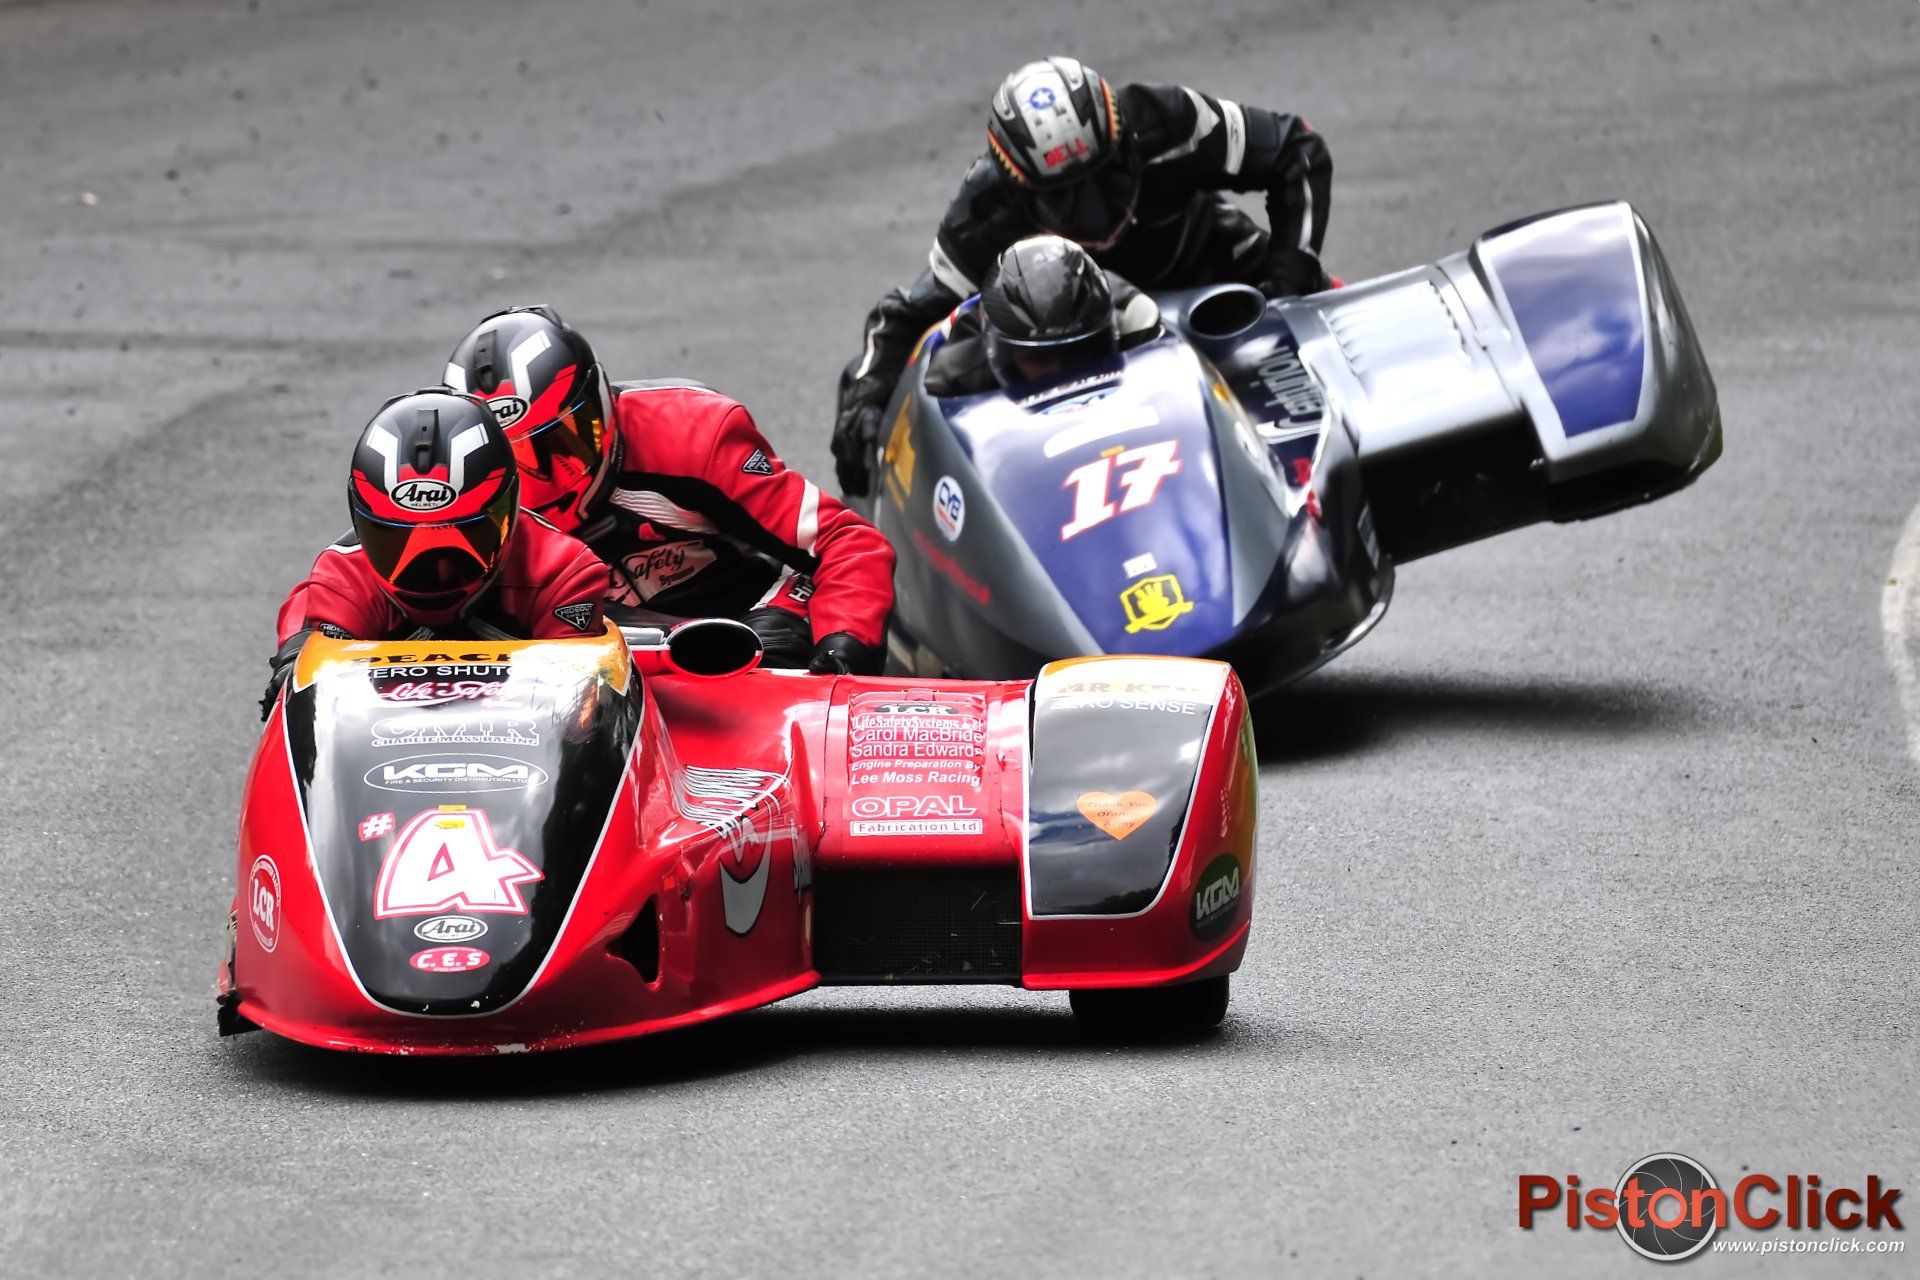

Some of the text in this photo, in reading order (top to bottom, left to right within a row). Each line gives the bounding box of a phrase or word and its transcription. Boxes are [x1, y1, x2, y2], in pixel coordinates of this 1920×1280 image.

[396, 484, 449, 502] Arai
[1060, 439, 1182, 542] 17
[368, 666, 427, 679] ERO
[1120, 699, 1197, 715] SENSE
[372, 736, 539, 746] CHARLIE MOSS RACING
[852, 727, 983, 743] Carol MacBride
[852, 743, 908, 757] Sandra
[384, 763, 528, 780] KGM
[852, 758, 981, 772] Engine Preparation By
[851, 771, 981, 787] Lee Moss Racing
[852, 795, 977, 818] OPAL
[859, 821, 977, 833] Fabrication Ltd
[374, 808, 545, 920] 4
[1196, 866, 1239, 921] KGM
[253, 878, 275, 932] LCR
[422, 921, 477, 935] Arai
